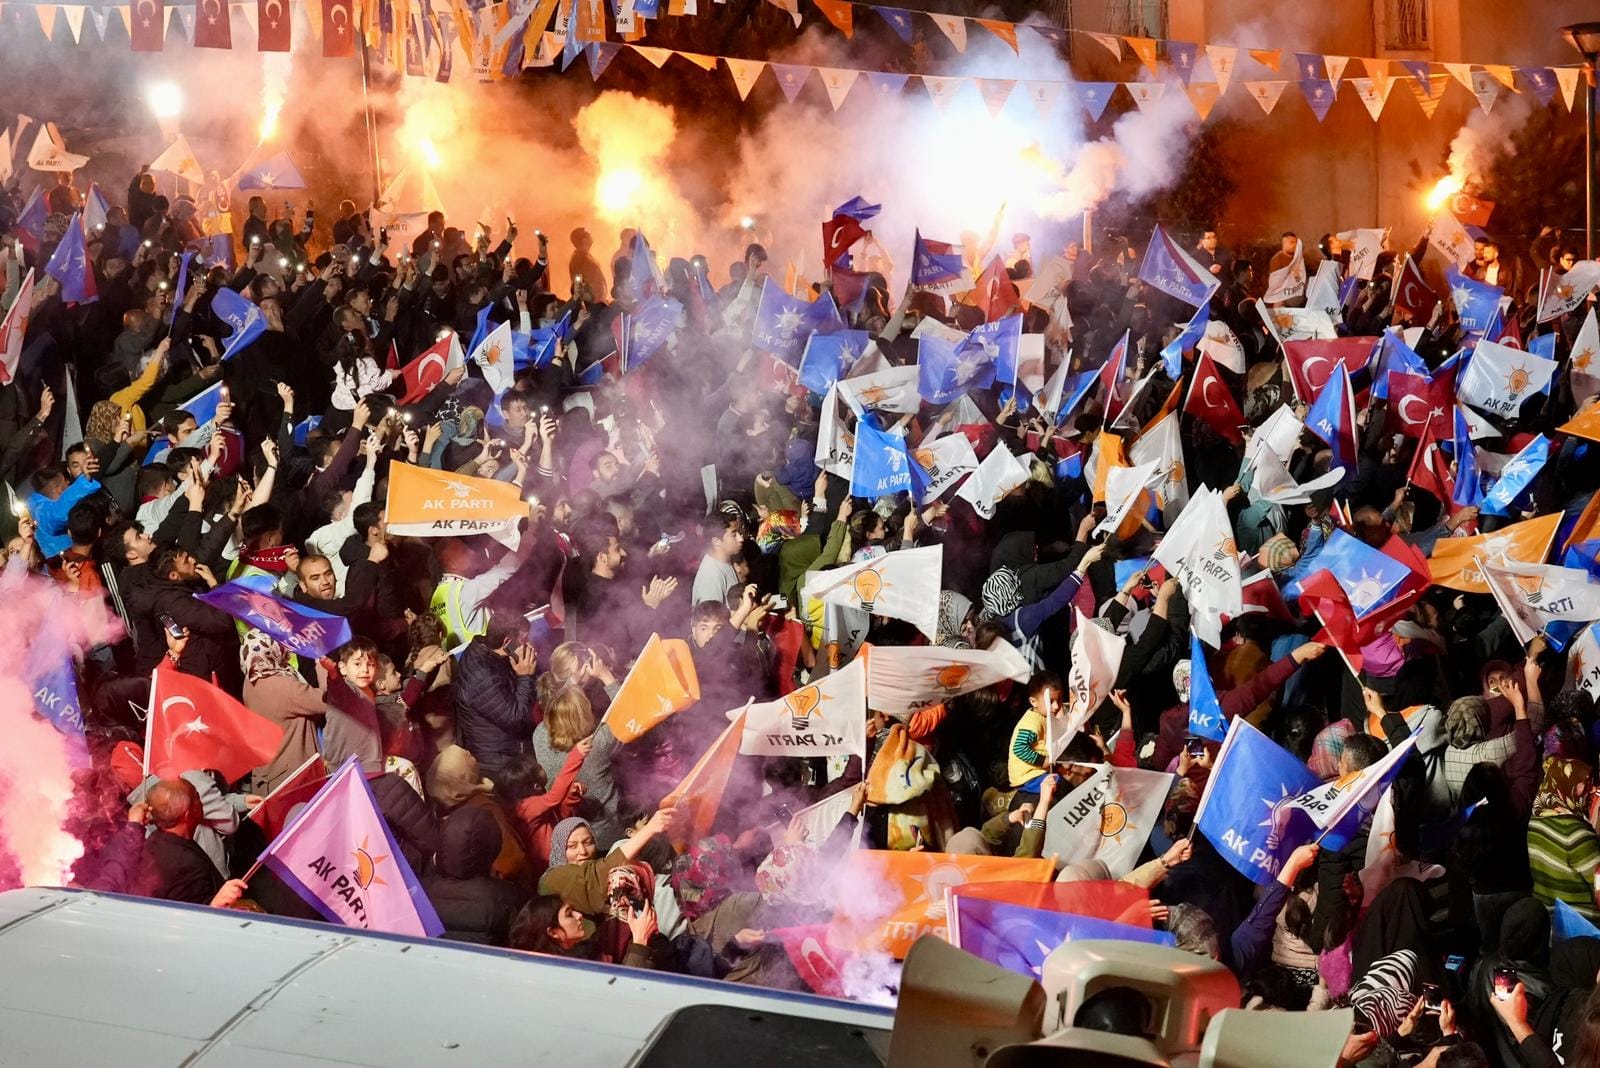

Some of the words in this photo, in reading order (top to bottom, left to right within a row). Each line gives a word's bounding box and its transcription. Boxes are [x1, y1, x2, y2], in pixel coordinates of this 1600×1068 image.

[1483, 398, 1501, 409] AK
[423, 500, 444, 509] AK
[432, 520, 454, 528] AK
[34, 686, 61, 710] AK
[1189, 709, 1214, 727] AK
[1221, 829, 1250, 856] AK
[308, 856, 336, 881] AK
